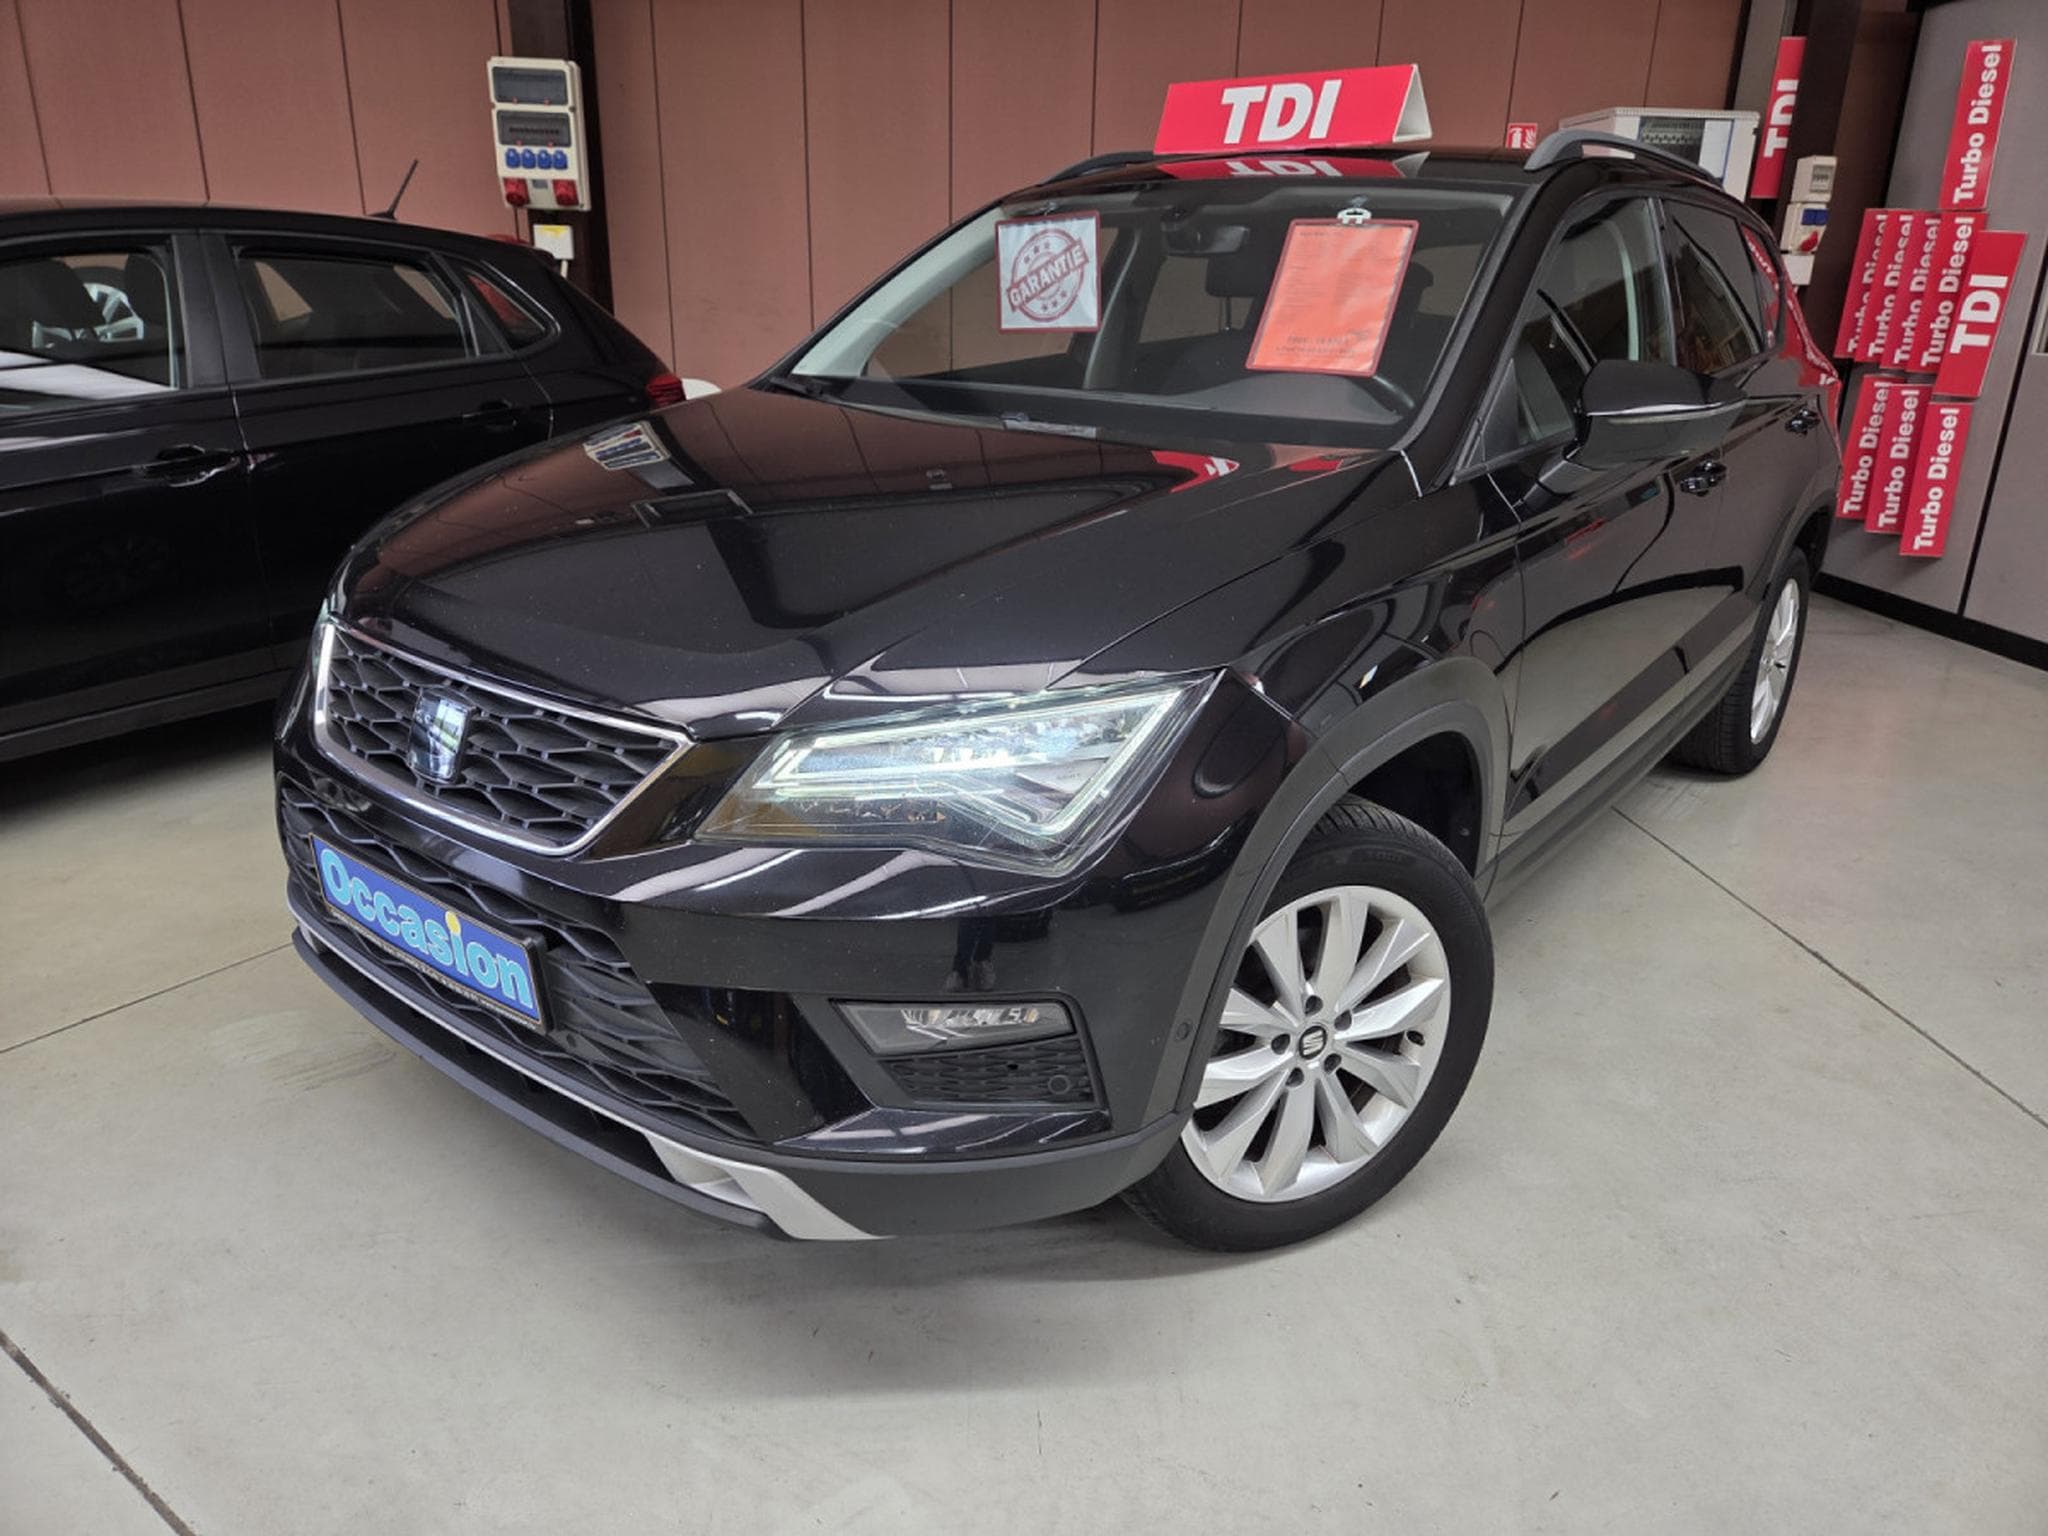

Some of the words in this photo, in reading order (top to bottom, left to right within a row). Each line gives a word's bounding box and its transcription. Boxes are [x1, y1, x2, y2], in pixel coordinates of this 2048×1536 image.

[1220, 79, 1342, 144] TDI
[1763, 79, 1800, 157] TDI
[1967, 44, 2003, 124] Diesel
[1952, 132, 1985, 204] Turbo
[1010, 245, 1085, 306] GARANTIE
[1893, 299, 1922, 364] Turbo
[1909, 218, 1941, 292] Diesel
[1920, 300, 1954, 366] Turbo
[1938, 217, 1975, 293] Diesel
[1950, 273, 2008, 354] TDI
[1842, 455, 1873, 514] Turbo
[1858, 381, 1891, 449] Diesel
[1889, 389, 1920, 459] Diesel
[1927, 408, 1960, 480] Diesel
[1878, 465, 1906, 528] Turbo
[1913, 486, 1944, 551] Turbo
[320, 848, 534, 1009] Occasion
